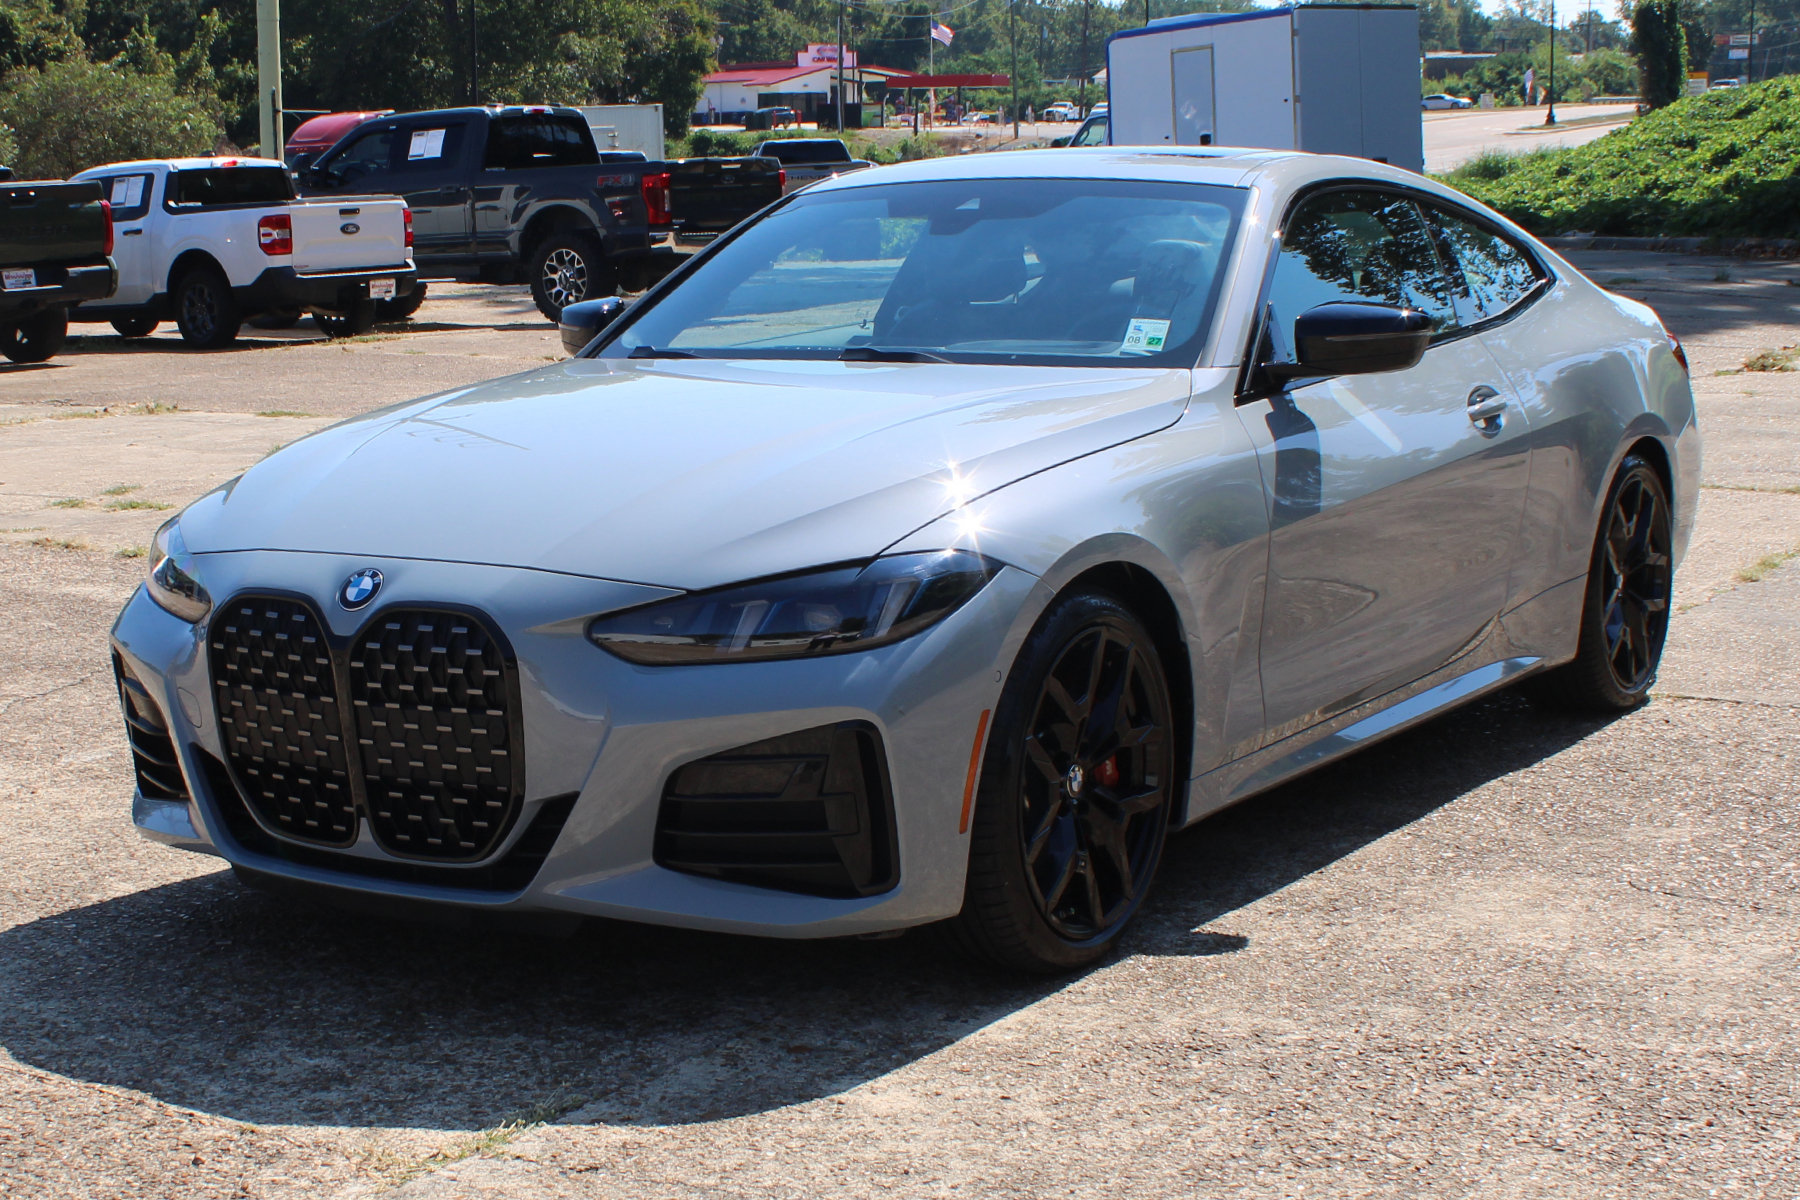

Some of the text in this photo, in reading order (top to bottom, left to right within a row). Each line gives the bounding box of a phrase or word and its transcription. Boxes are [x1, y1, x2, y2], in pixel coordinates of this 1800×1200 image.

[1128, 335, 1162, 345] 08 27
[350, 570, 381, 583] BMW
